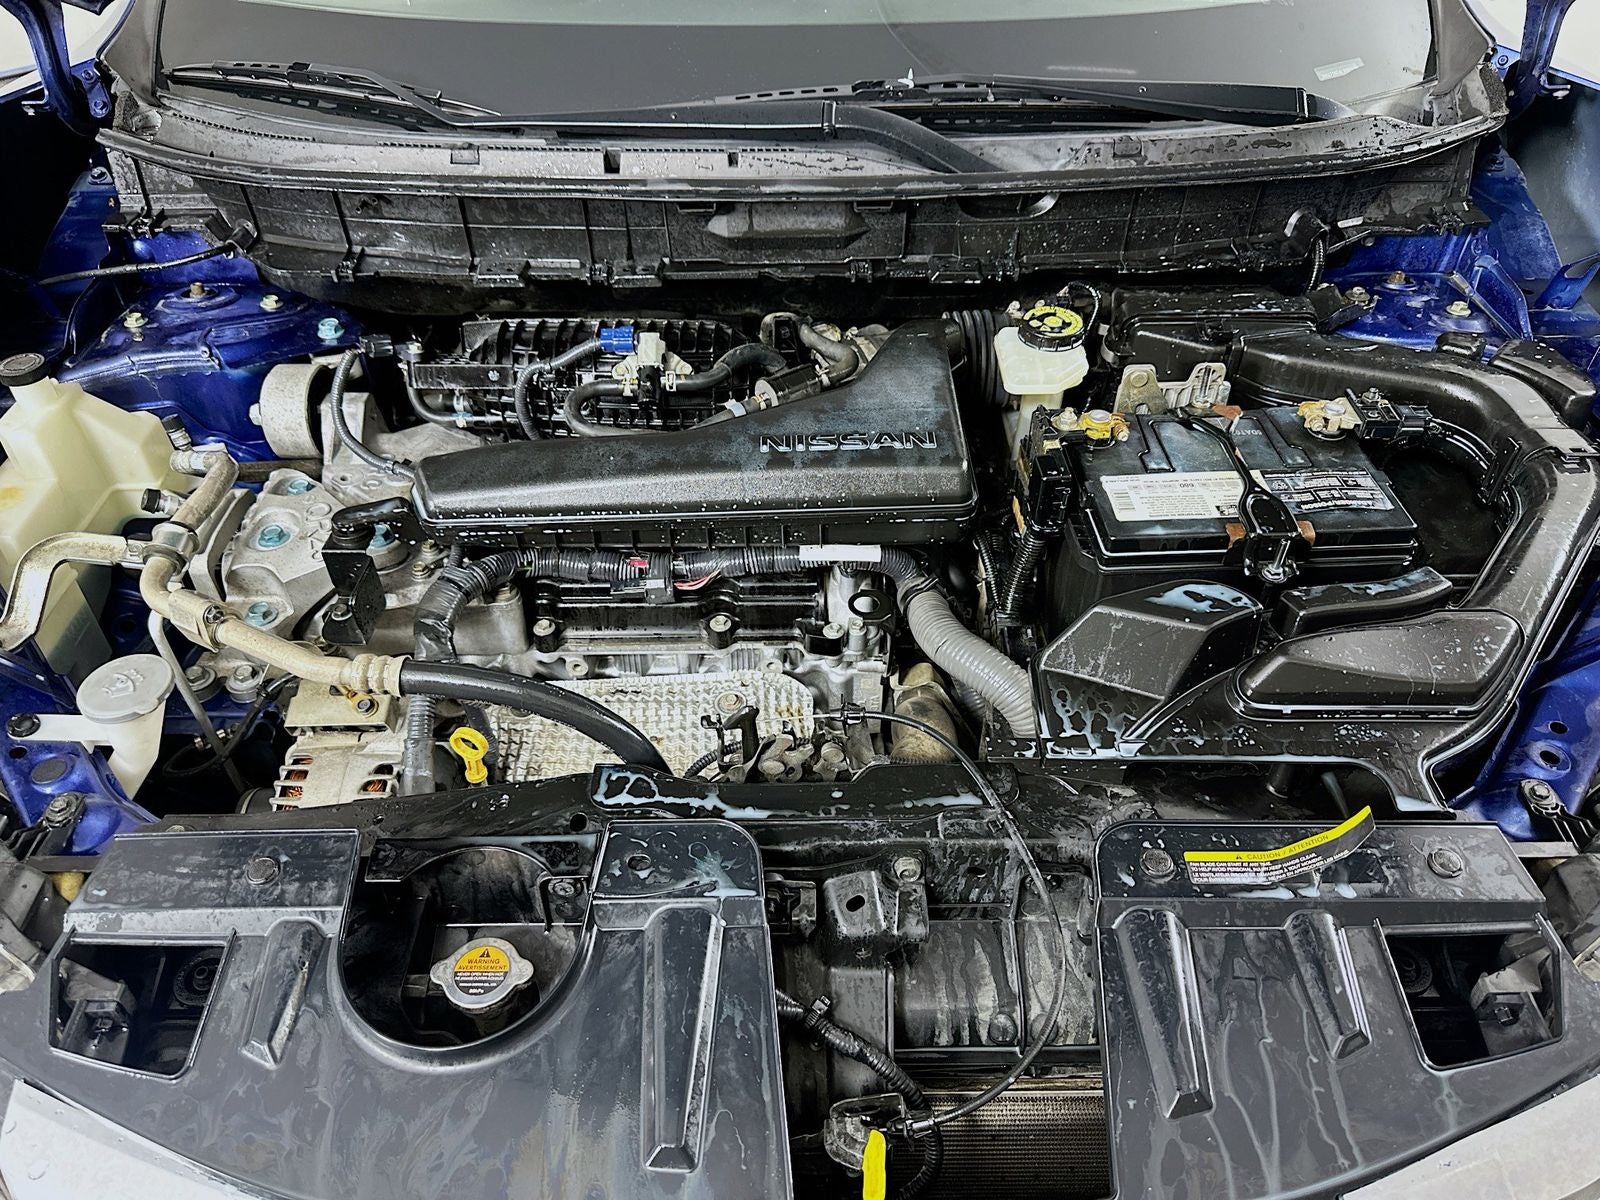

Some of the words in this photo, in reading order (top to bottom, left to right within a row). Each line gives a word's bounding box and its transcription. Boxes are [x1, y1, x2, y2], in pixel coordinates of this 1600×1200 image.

[759, 431, 937, 453] NISSAN
[1246, 852, 1281, 861] CAUTION
[1288, 834, 1329, 853] ATTENTION
[1282, 858, 1300, 867] HANDS
[1294, 860, 1324, 874] APPROCHER
